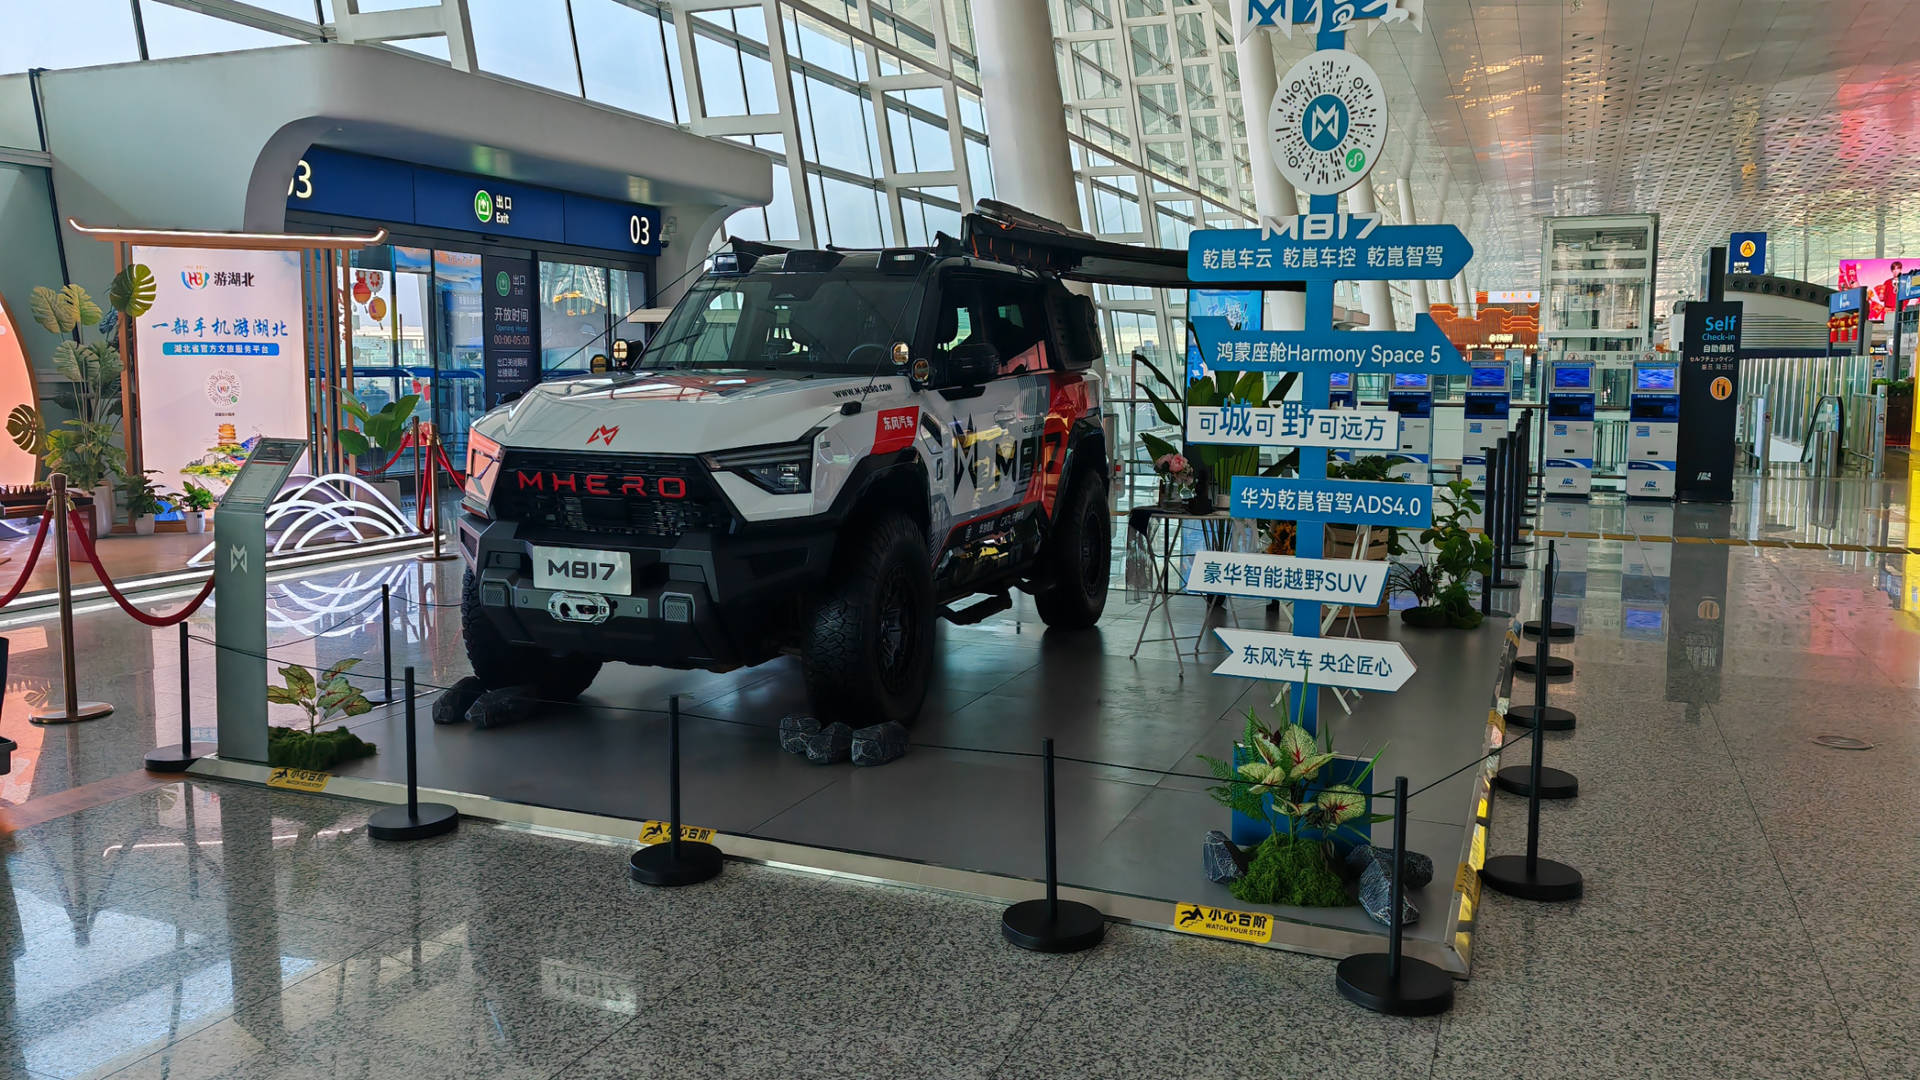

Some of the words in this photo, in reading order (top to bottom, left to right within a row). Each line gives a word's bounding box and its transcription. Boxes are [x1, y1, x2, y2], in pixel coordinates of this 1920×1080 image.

[287, 159, 313, 199] 3
[495, 194, 512, 211] 出口
[495, 212, 510, 225] Exit
[630, 214, 650, 245] 03
[1261, 212, 1383, 241] M817
[1202, 247, 1273, 270] 乾崑车云
[1283, 246, 1357, 269] 乾崑车控
[1366, 246, 1444, 269] 乾崑智驾
[213, 271, 255, 288] 游湖北
[512, 274, 526, 285] 出口
[494, 306, 529, 322] 开放时间
[1705, 315, 1737, 332] Self
[151, 316, 289, 338] 一部手机游湖北
[1702, 332, 1736, 341] Check-in
[173, 343, 270, 354] 湖北省官方文旅服务平台
[1215, 341, 1366, 368] 鸿蒙座舱Harmony
[1371, 344, 1424, 368] Space
[1430, 345, 1441, 364] 5
[1703, 344, 1735, 353] 自助值机
[832, 383, 893, 399] WWW.M-HERO.COM
[882, 415, 915, 432] 东风汽车
[1199, 398, 1387, 442] 可城可野可远方
[517, 470, 687, 499] MHERO
[1240, 486, 1422, 517] 华为乾崑智驾ADS4.0
[547, 559, 616, 582] M817
[1203, 561, 1367, 593] 豪华智能越野SUV
[1242, 644, 1313, 669] 东风汽车
[1318, 653, 1394, 679] 央企匠心
[1205, 922, 1229, 932] WATCH
[1229, 926, 1249, 935] YOUR
[1249, 929, 1267, 937] STEP
[1208, 908, 1268, 930] 小心台阶
